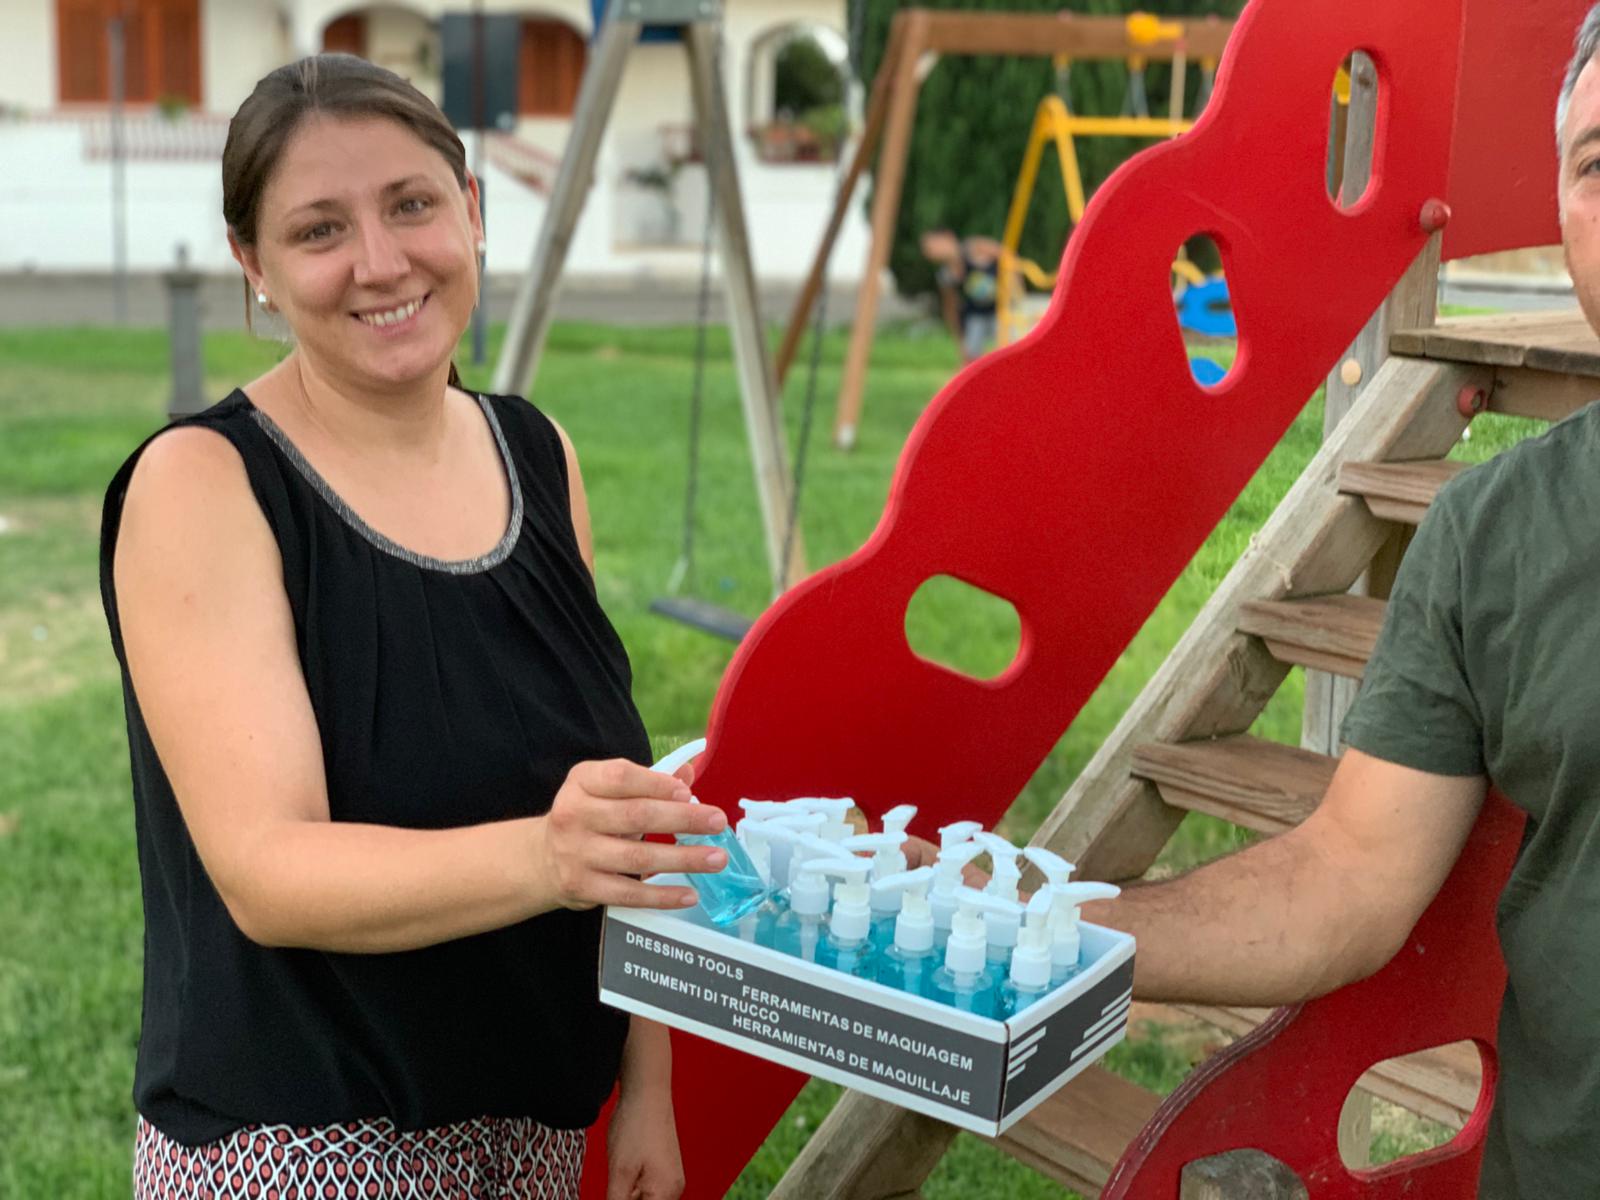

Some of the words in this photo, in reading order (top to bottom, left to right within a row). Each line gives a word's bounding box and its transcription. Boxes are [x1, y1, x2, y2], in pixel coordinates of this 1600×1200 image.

[623, 961, 702, 997] STRUMENTI
[703, 988, 718, 1005] DI
[720, 994, 780, 1025] TRUCCO
[625, 930, 695, 966] DRESSING
[697, 955, 745, 981] TOOLS
[732, 1013, 846, 1063] HERRAMIENTAS
[848, 1052, 869, 1071] DE
[872, 1060, 971, 1106] MAQUILLAJE
[741, 985, 850, 1032] FERRAMENTAS
[852, 1021, 873, 1040] DE
[876, 1029, 974, 1071] MAQUIAGEM
